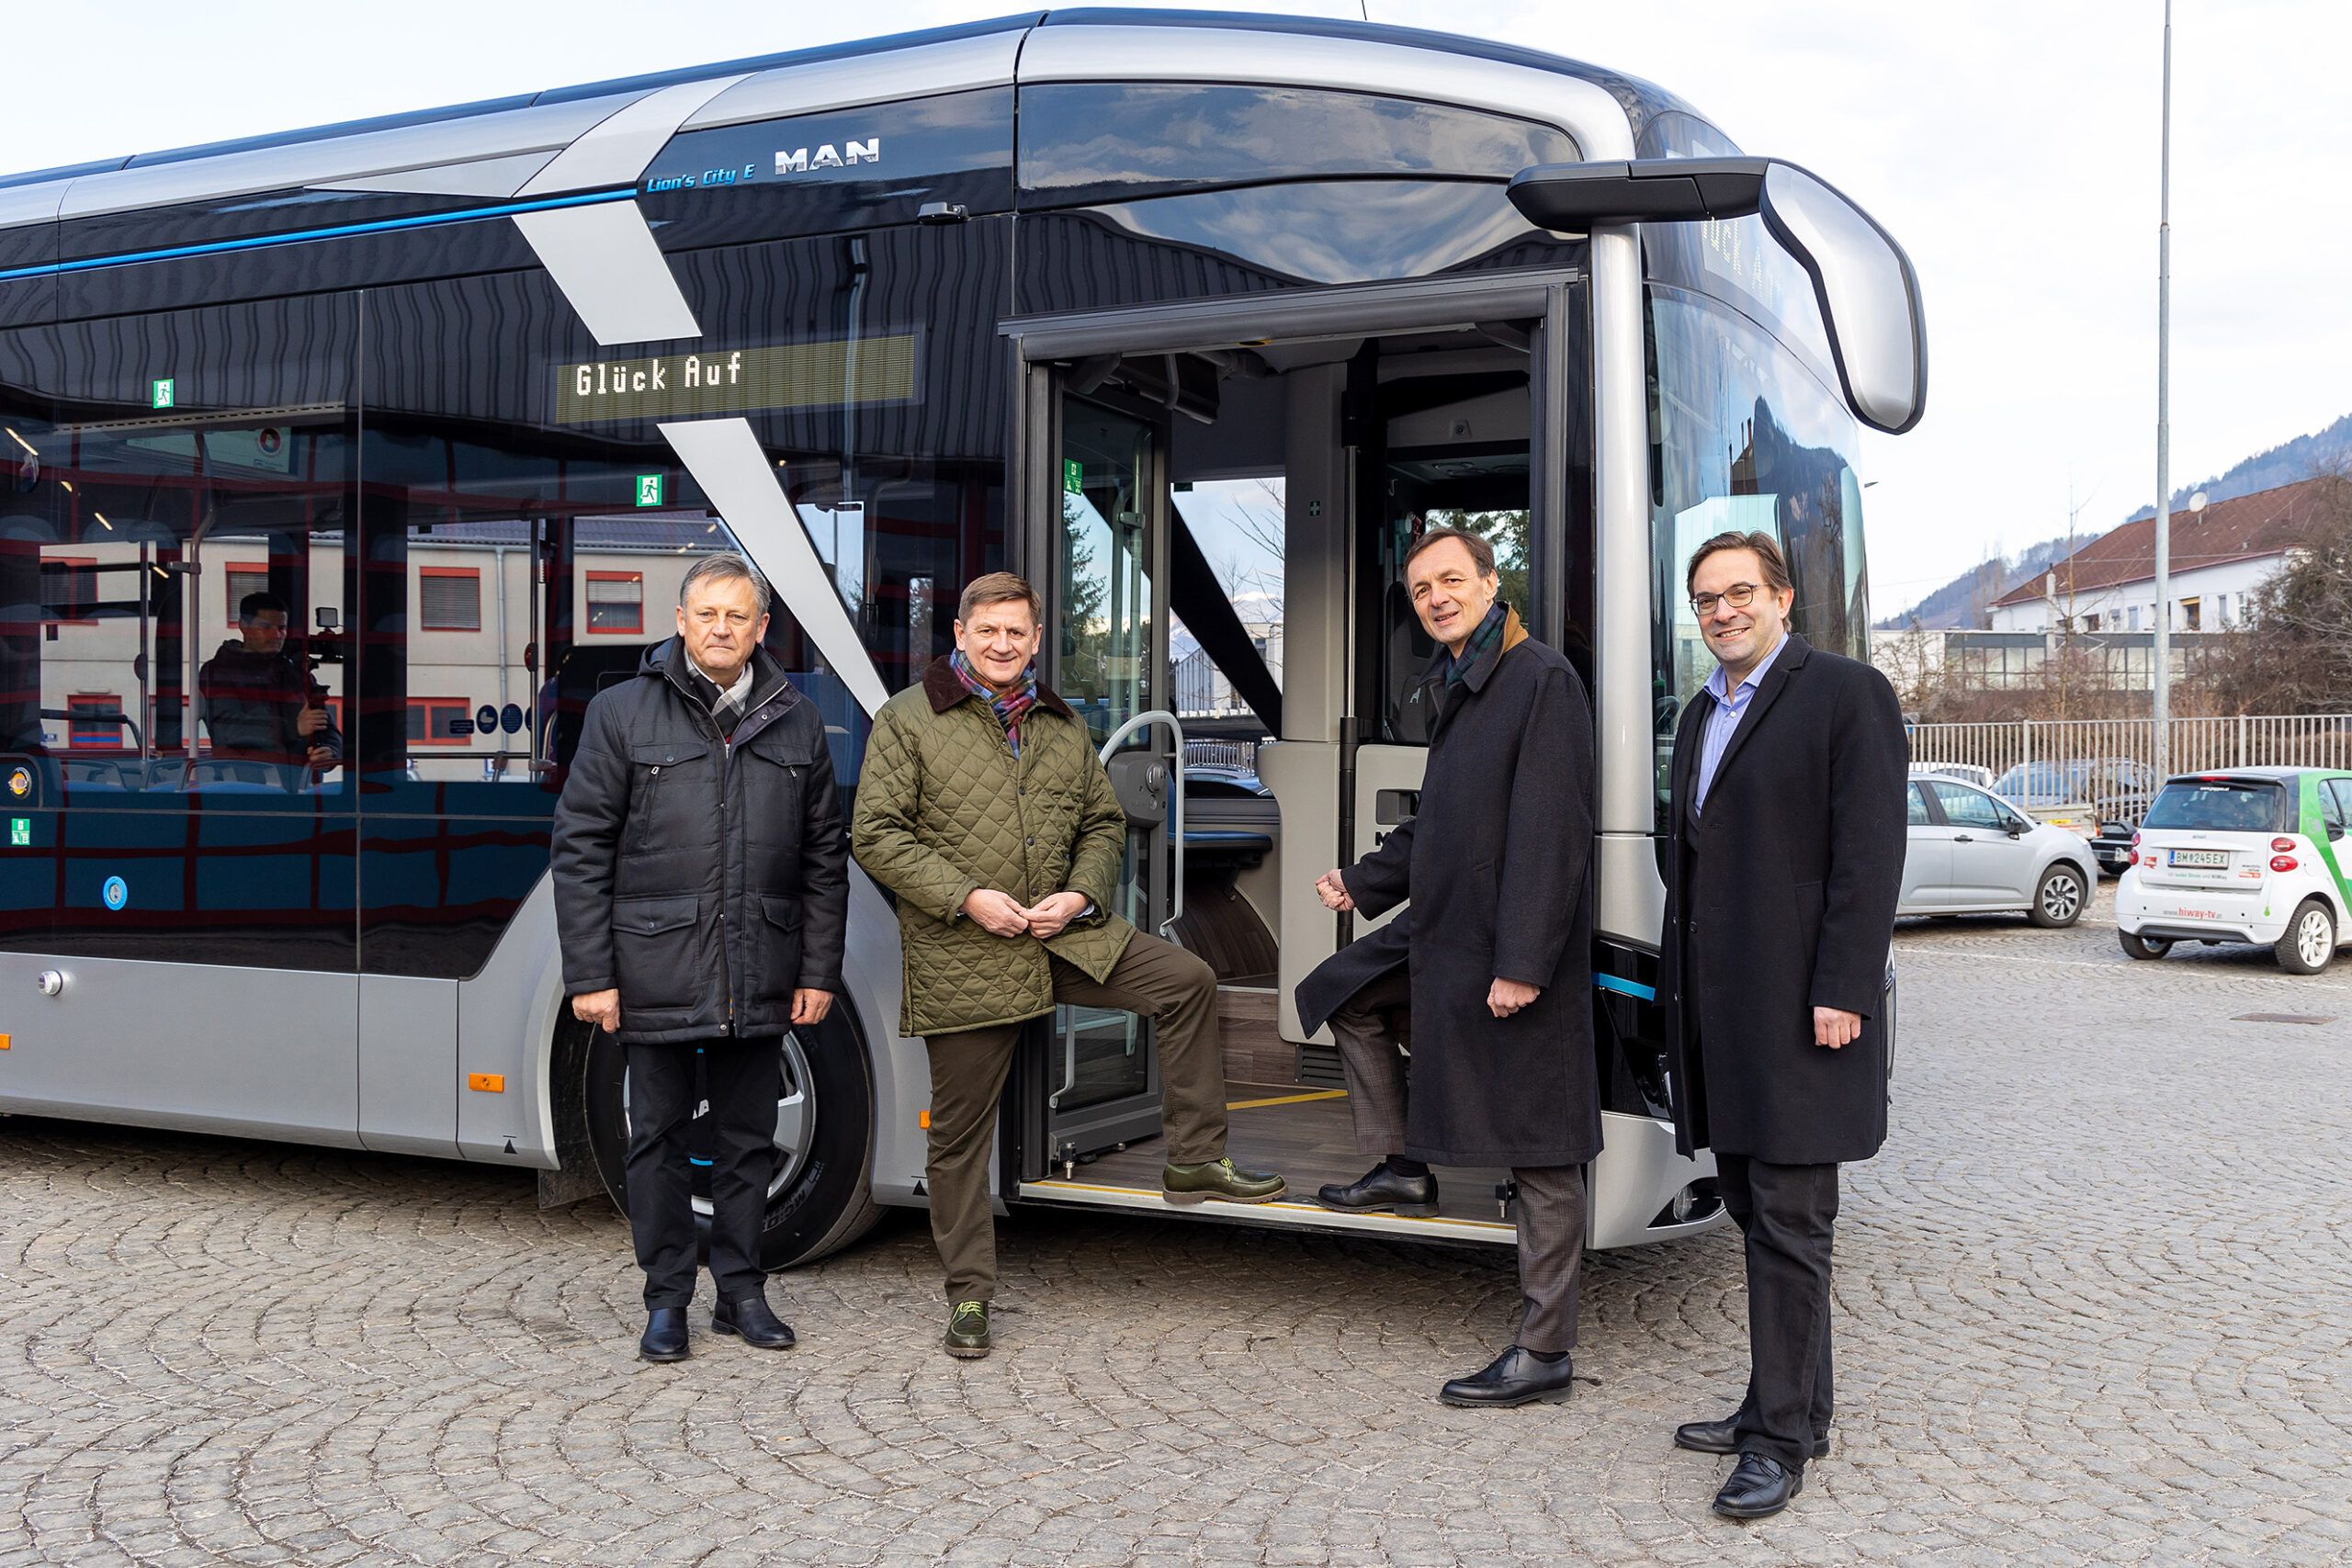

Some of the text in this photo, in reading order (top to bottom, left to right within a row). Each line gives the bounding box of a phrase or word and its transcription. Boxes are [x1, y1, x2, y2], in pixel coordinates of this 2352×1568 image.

[775, 138, 879, 175] MAN
[646, 164, 756, 193] Lion's City E
[576, 352, 741, 396] Glück Auf
[2176, 852, 2188, 863] BM
